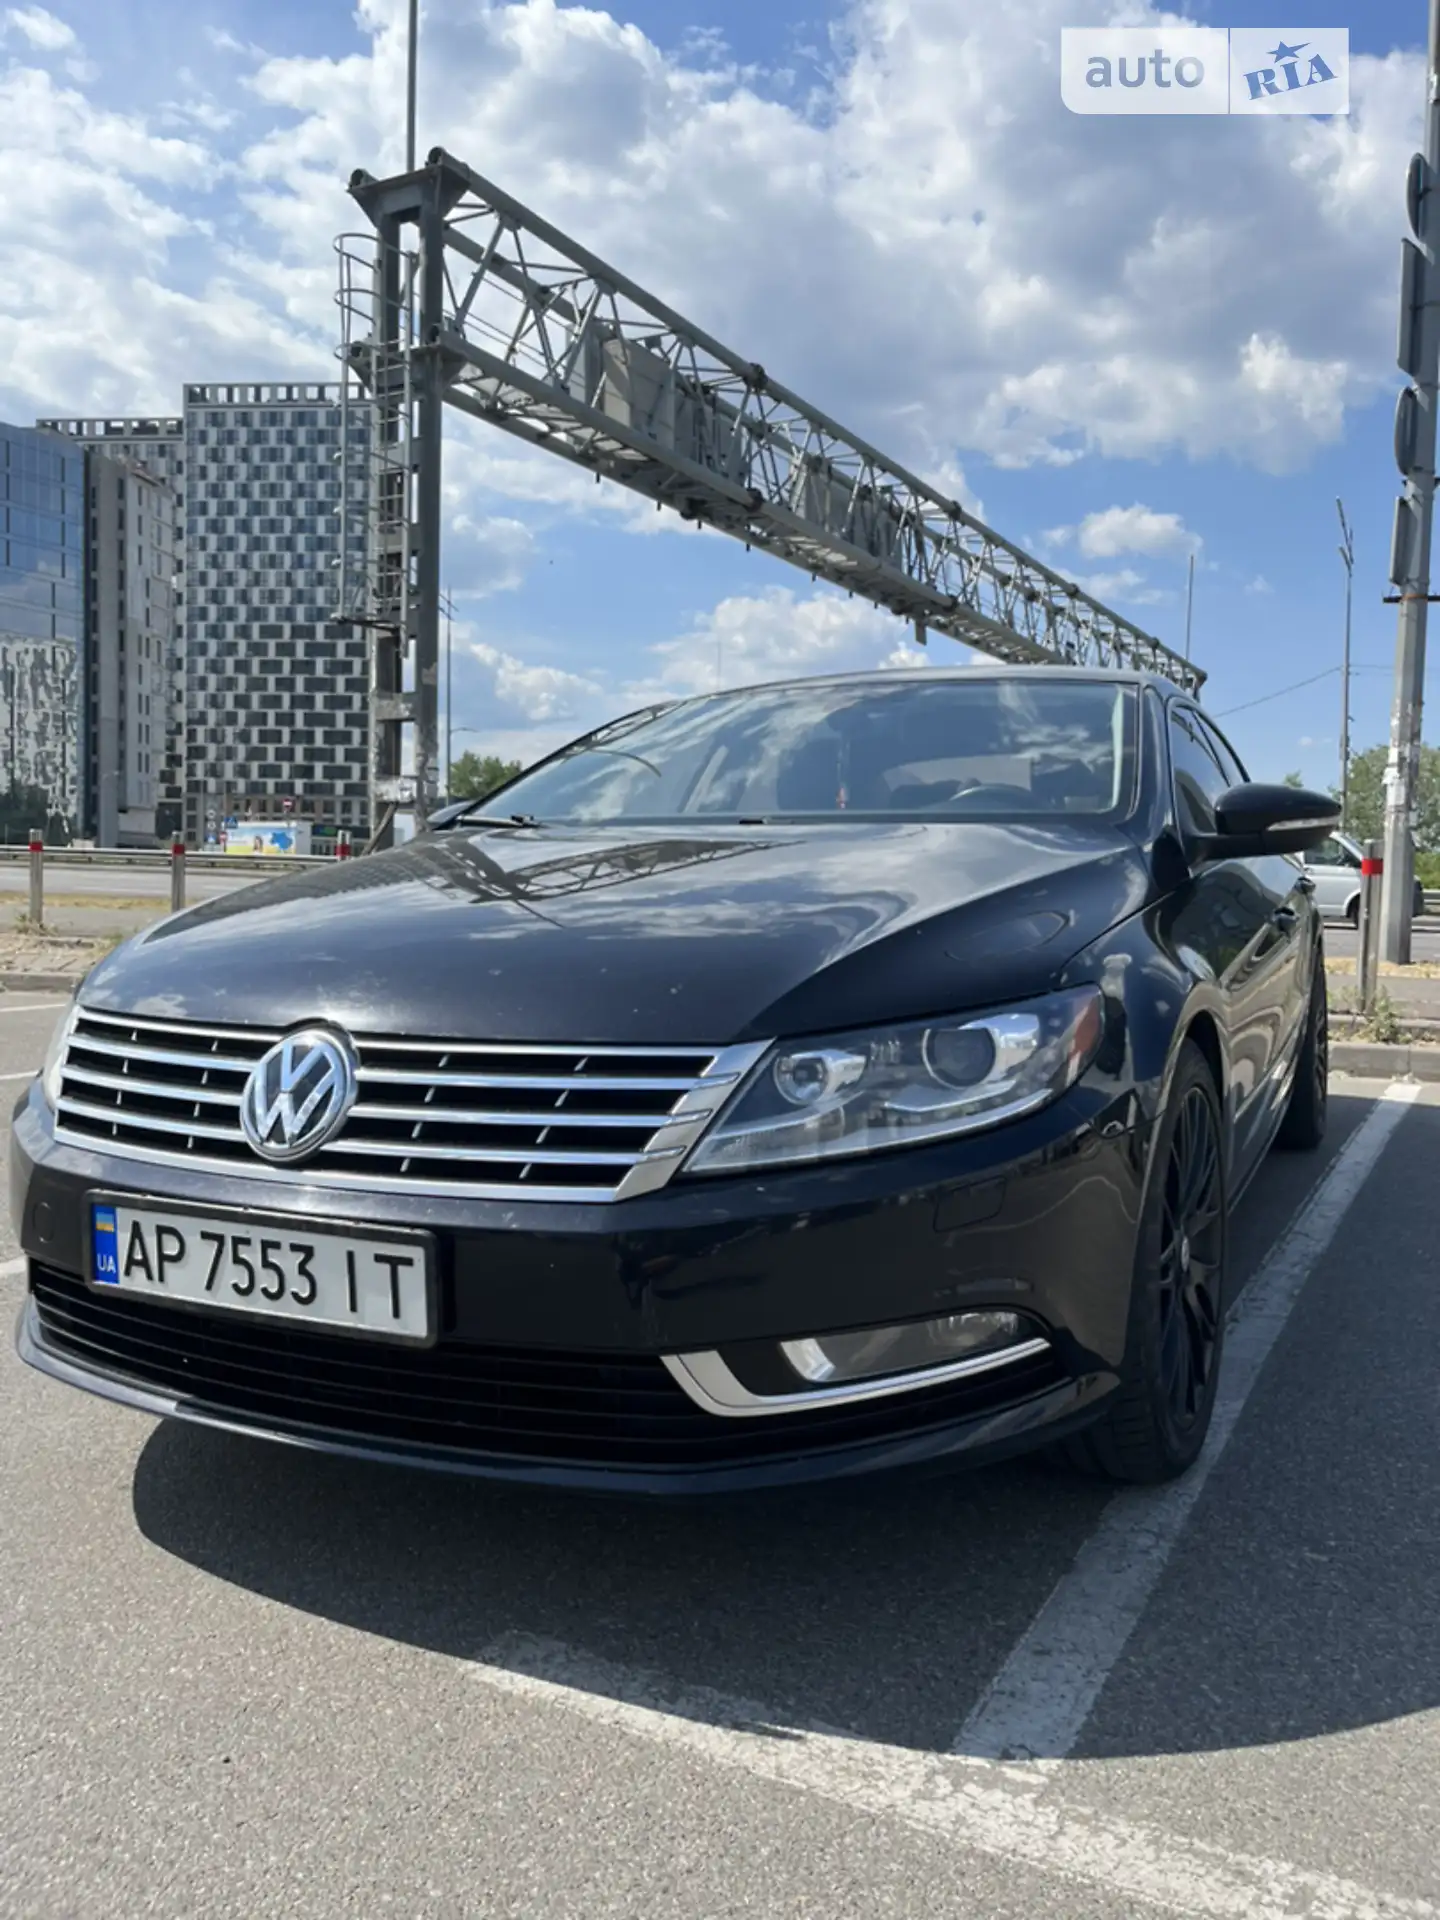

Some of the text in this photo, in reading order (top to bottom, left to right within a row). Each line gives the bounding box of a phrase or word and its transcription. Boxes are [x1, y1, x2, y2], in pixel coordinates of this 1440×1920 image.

[96, 1253, 117, 1275] UA
[123, 1220, 414, 1319] AP 7553 IT
